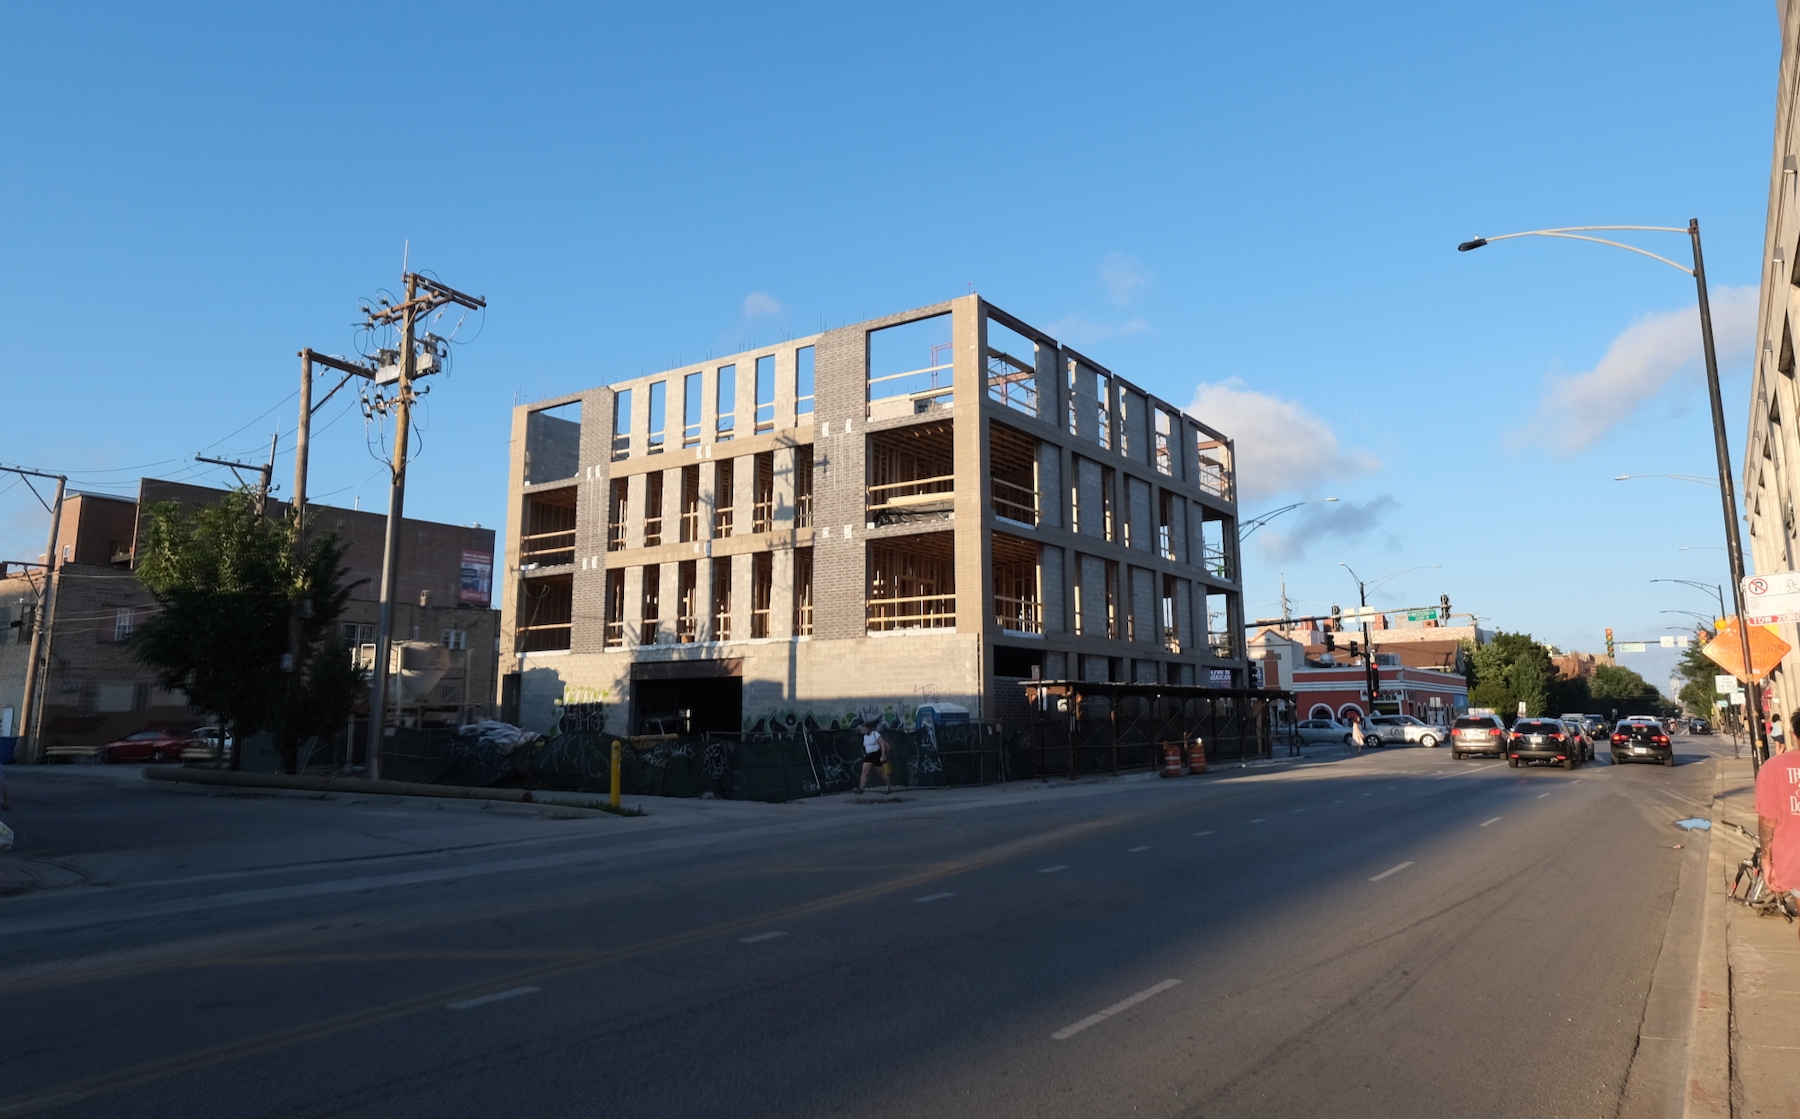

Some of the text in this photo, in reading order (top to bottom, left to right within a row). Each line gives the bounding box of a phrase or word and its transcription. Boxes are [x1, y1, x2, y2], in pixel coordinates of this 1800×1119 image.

[1752, 613, 1800, 624] TOW ZONE
[1733, 631, 1759, 640] RD
[1711, 644, 1784, 655] CONSTUCTION
[1734, 659, 1766, 668] AHAD
